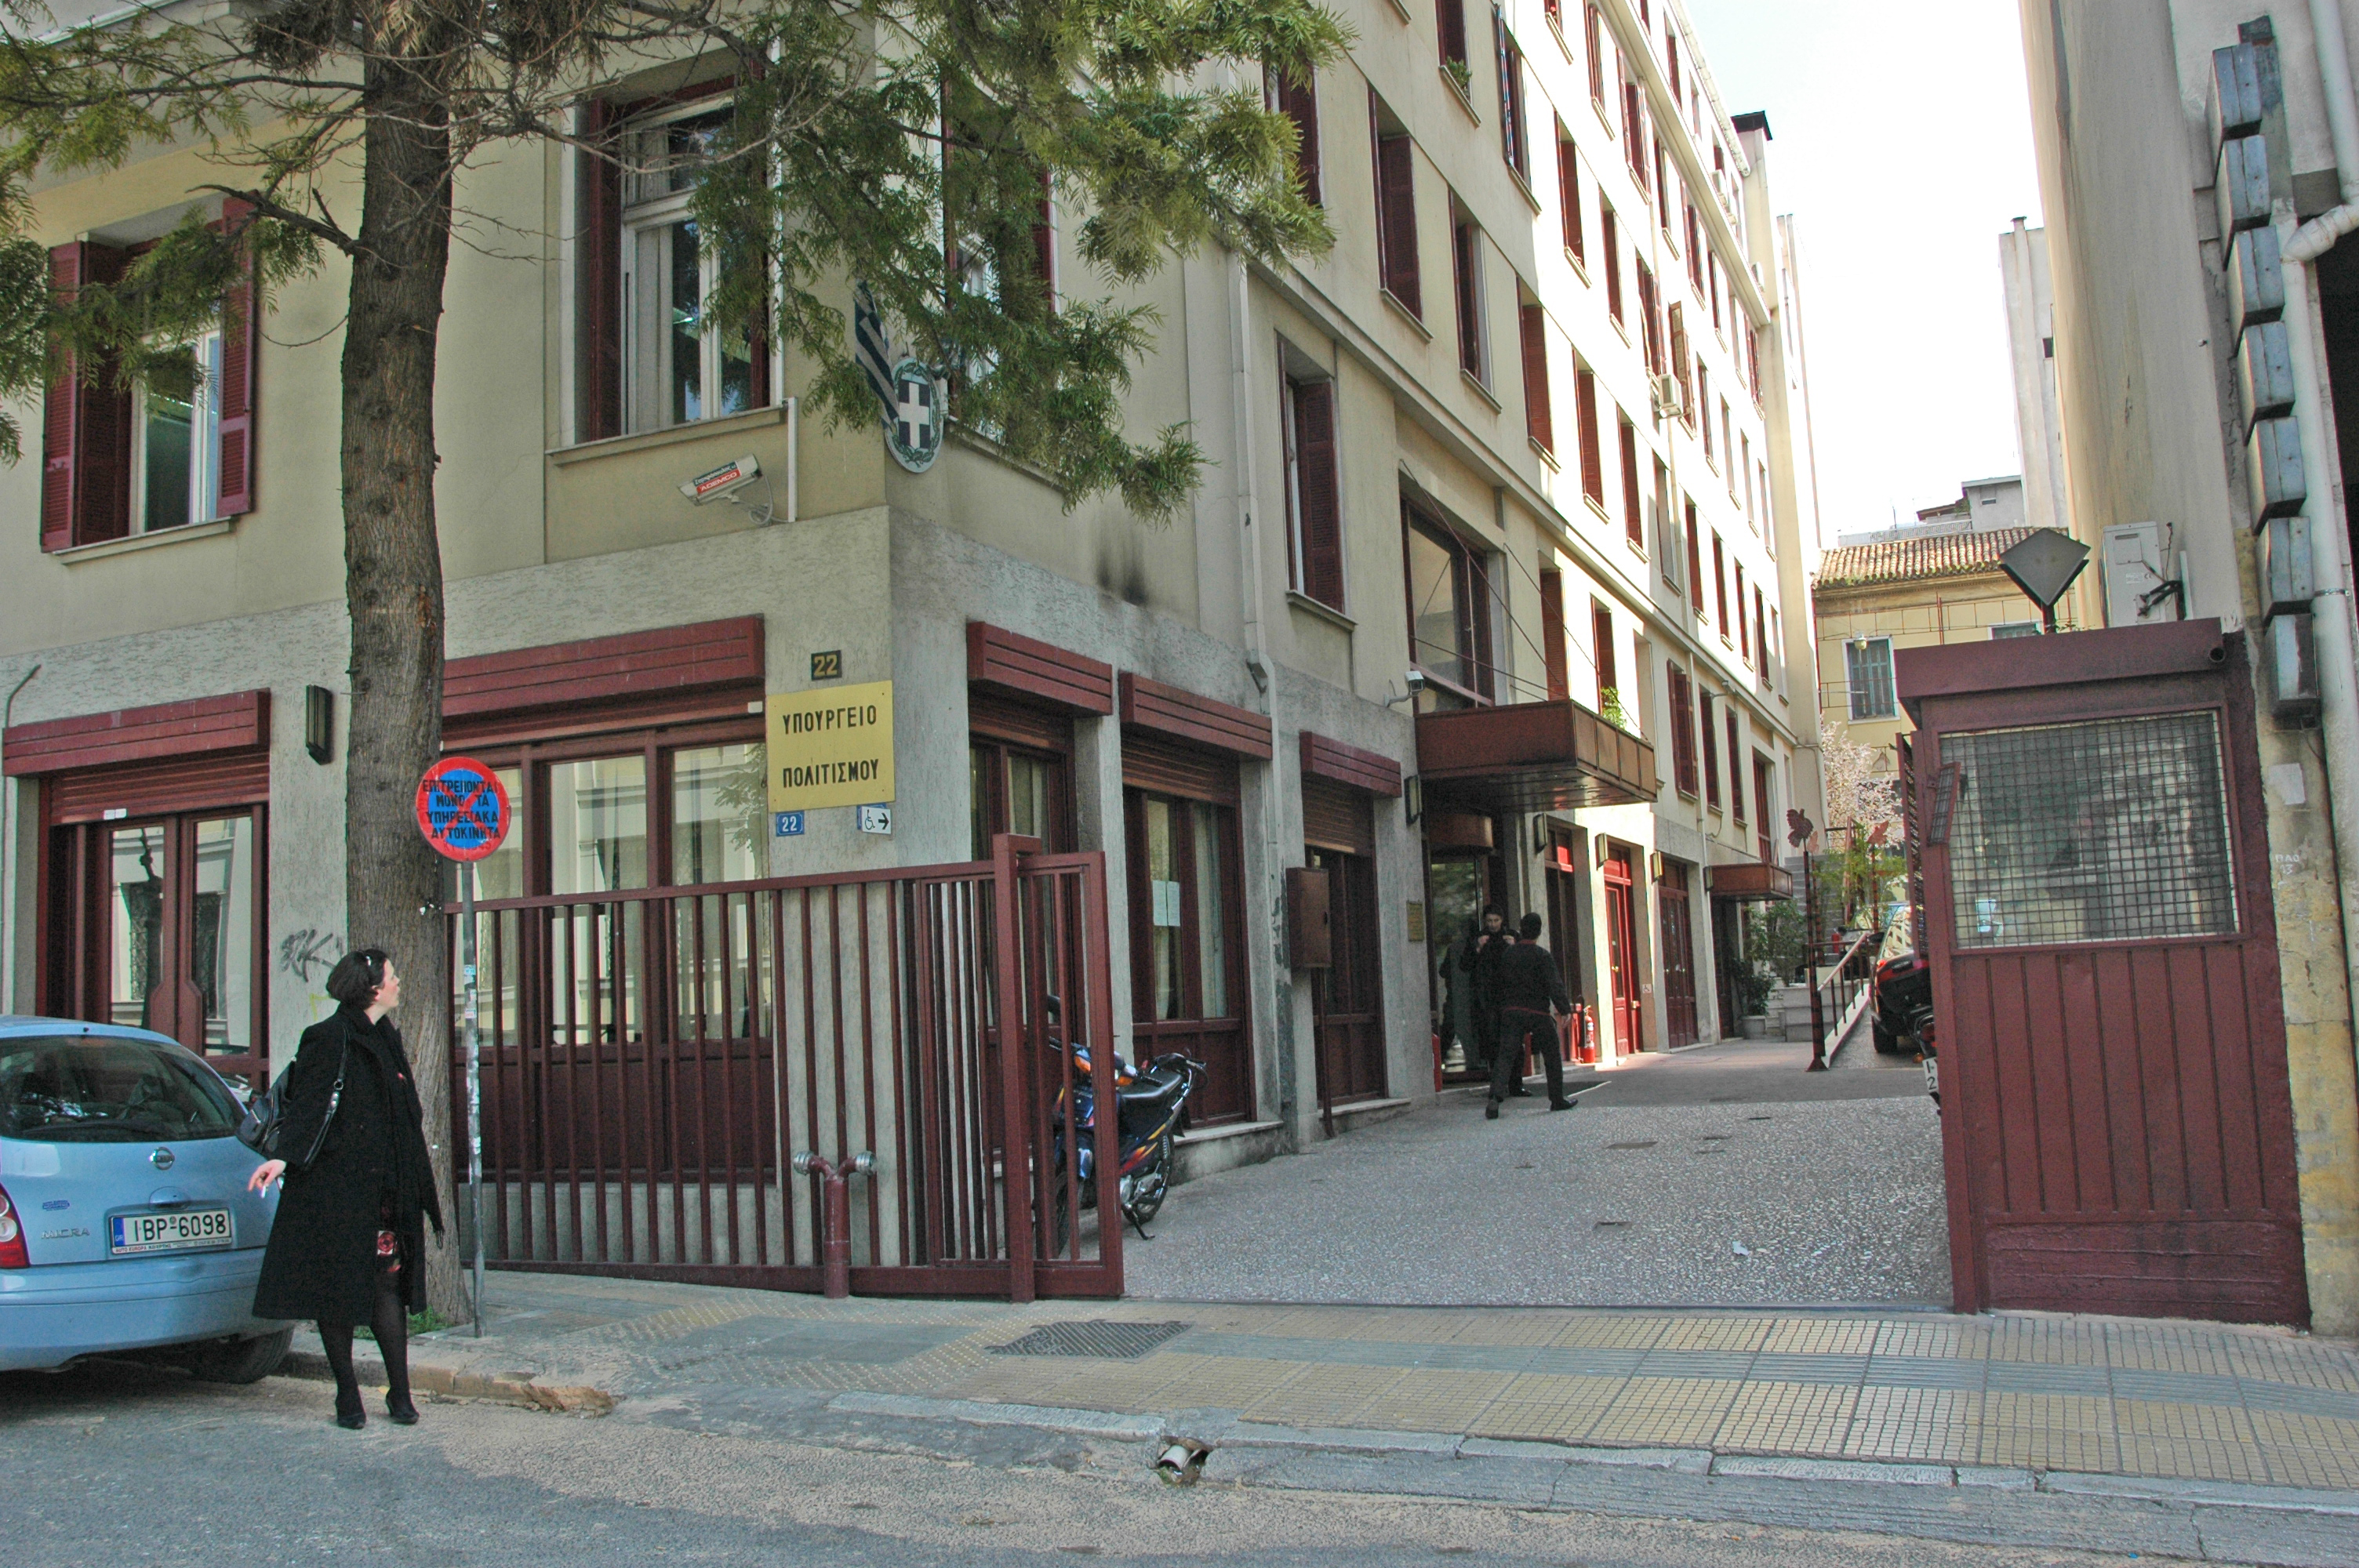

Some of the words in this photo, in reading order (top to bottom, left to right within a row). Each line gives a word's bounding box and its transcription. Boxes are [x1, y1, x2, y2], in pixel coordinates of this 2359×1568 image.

[813, 654, 838, 677] 22
[783, 705, 877, 735] ΥΠΟΥΡΓΕΙΟ
[783, 758, 879, 789] ΠΟΛΙΤΙΣΜΟΥ
[436, 795, 465, 808] ΜΟΝΟ
[475, 794, 490, 807] ΤΑ
[426, 811, 499, 824] ΥΠΗΡΕΣΙΑΚΑ
[782, 815, 798, 833] 22
[432, 826, 500, 840] ΑΥΤΟΚΙΝΗΤΑ
[42, 1228, 90, 1239] MICRA
